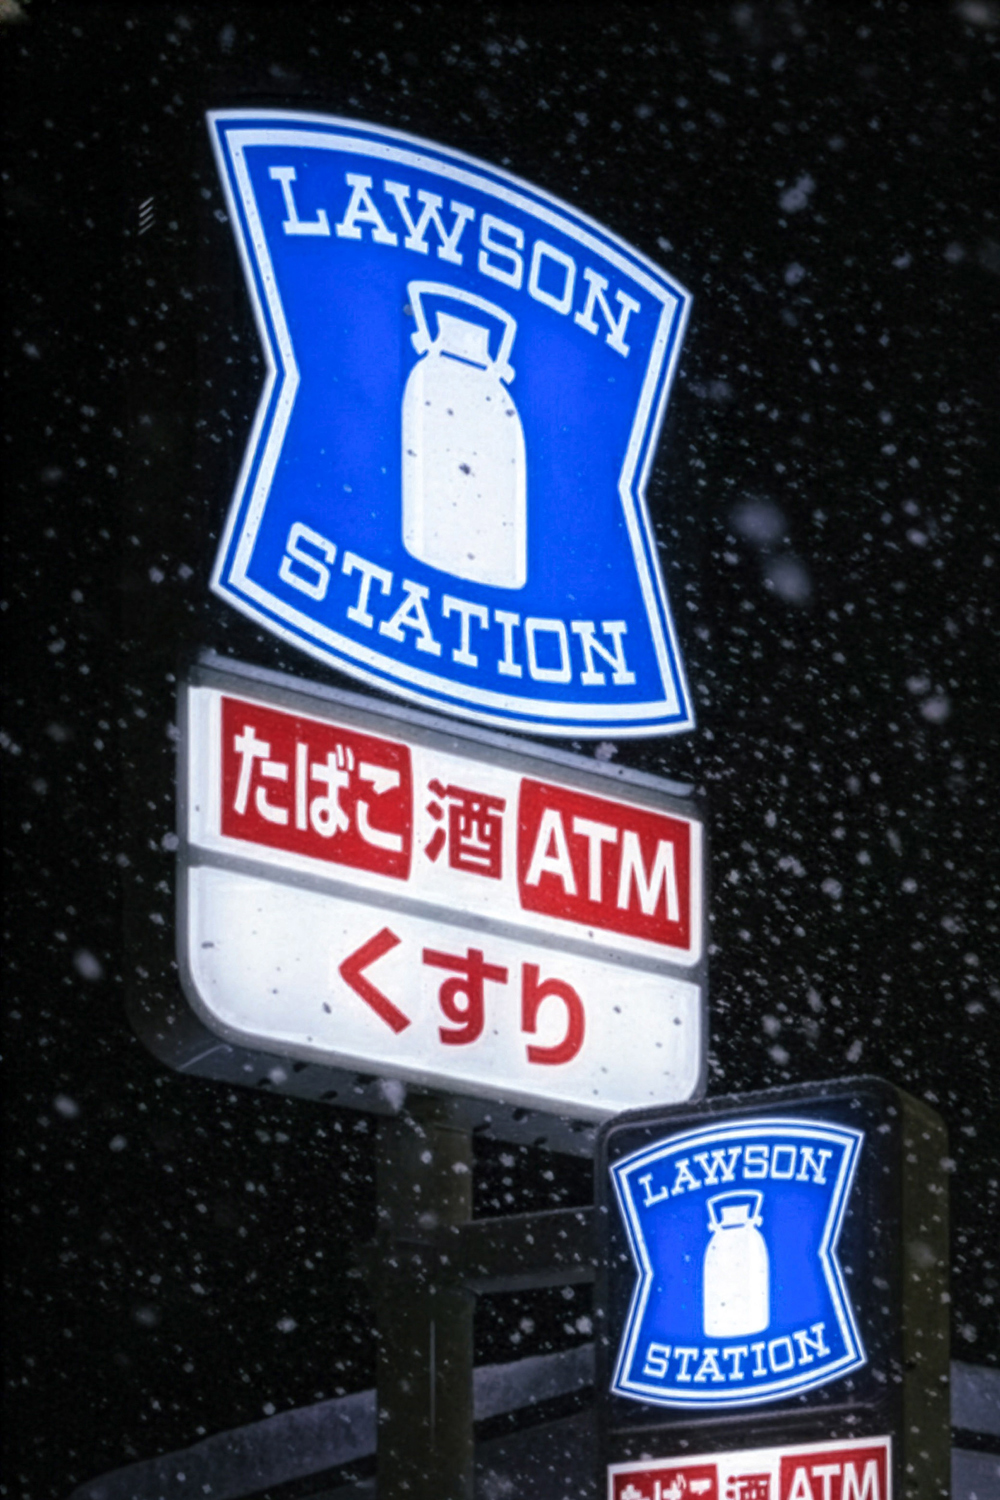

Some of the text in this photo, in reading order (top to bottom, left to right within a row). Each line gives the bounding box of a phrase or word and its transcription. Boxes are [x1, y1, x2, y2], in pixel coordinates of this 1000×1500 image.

[269, 166, 641, 358] LAWSON
[279, 521, 636, 687] STATION
[233, 725, 681, 922] たばこ 酒 ATM
[338, 926, 586, 1066] くすり
[638, 1145, 833, 1207] LAWSON
[643, 1323, 831, 1382] STATION
